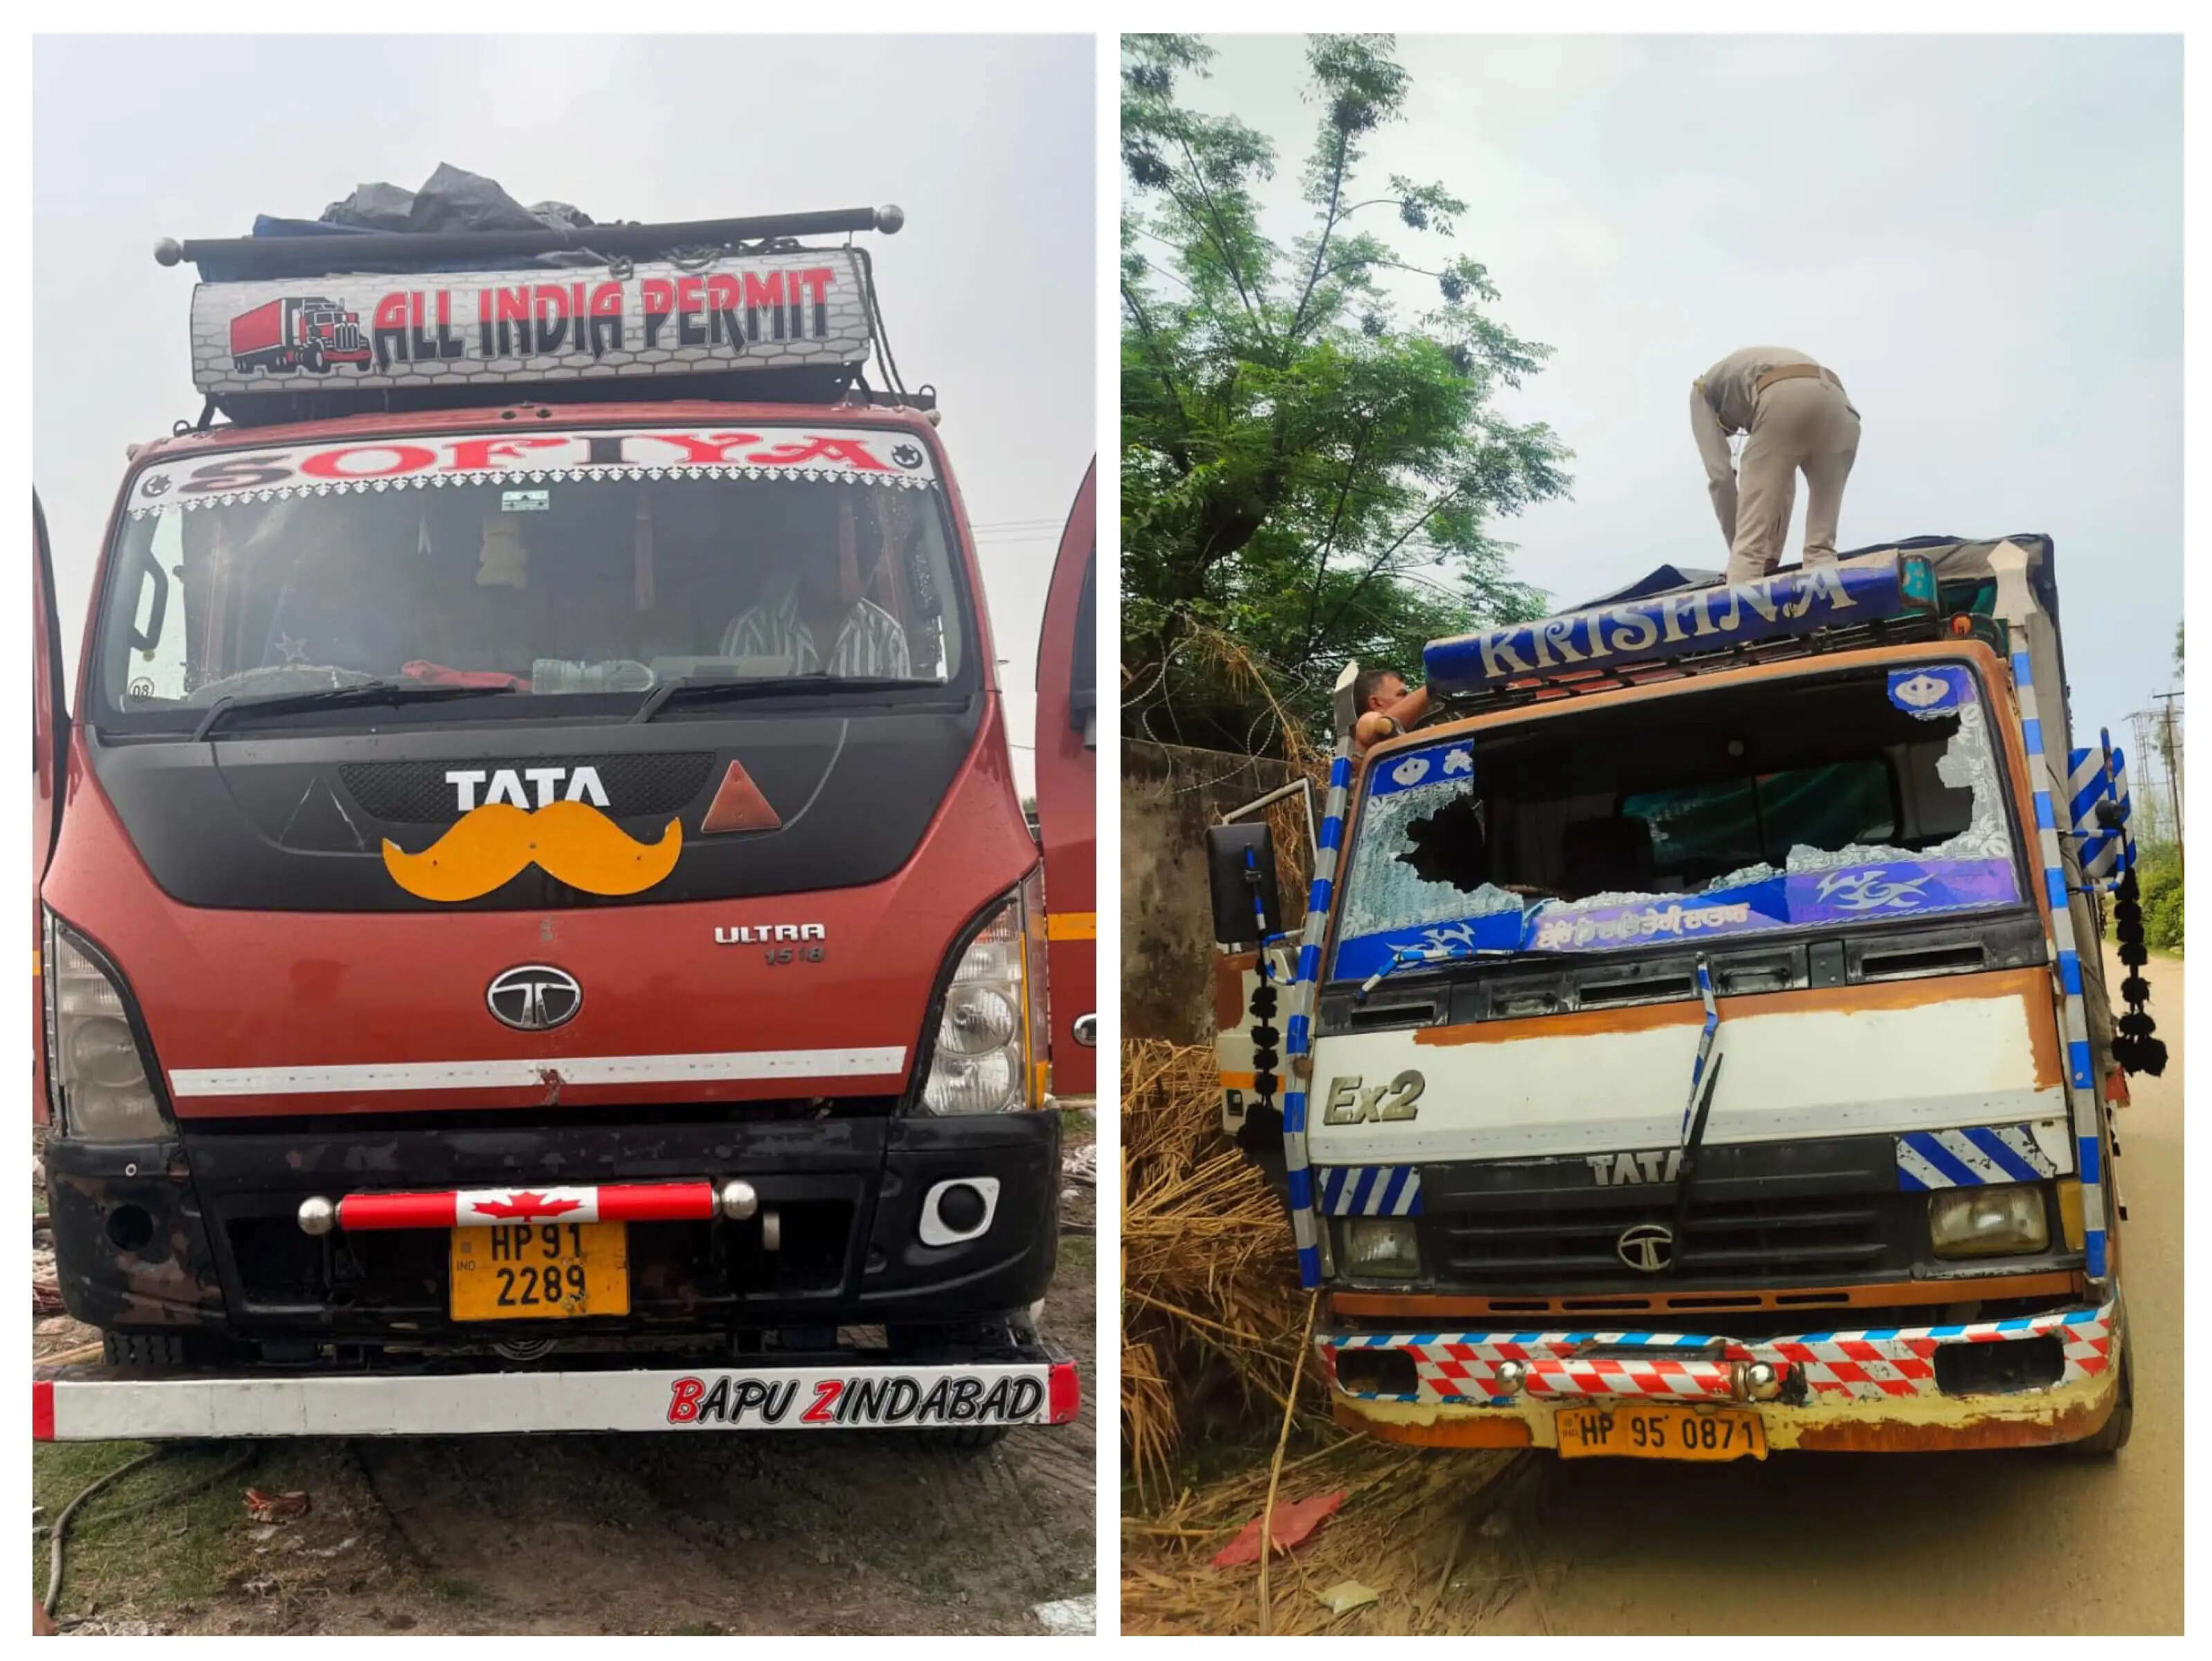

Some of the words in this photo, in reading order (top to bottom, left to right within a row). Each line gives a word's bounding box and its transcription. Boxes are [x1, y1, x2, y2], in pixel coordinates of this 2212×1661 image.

[372, 290, 464, 374] ALL
[478, 278, 625, 362] INDIA
[641, 266, 835, 356] PERMIT
[178, 432, 908, 495] SOFIYA
[1479, 563, 1859, 679] KRISHNA
[445, 766, 611, 812] TATA
[714, 923, 826, 943] ULTRA
[1323, 1069, 1426, 1125] Ex2
[490, 1224, 532, 1262] HP
[541, 1222, 581, 1260] 91
[456, 1260, 476, 1272] IND
[496, 1264, 586, 1307] 2289
[667, 1376, 799, 1424] BAPU
[799, 1375, 1045, 1424] ZINDABAD
[1581, 1414, 1614, 1447] HP
[1631, 1416, 1667, 1449] 95
[1681, 1418, 1754, 1450] 0871
